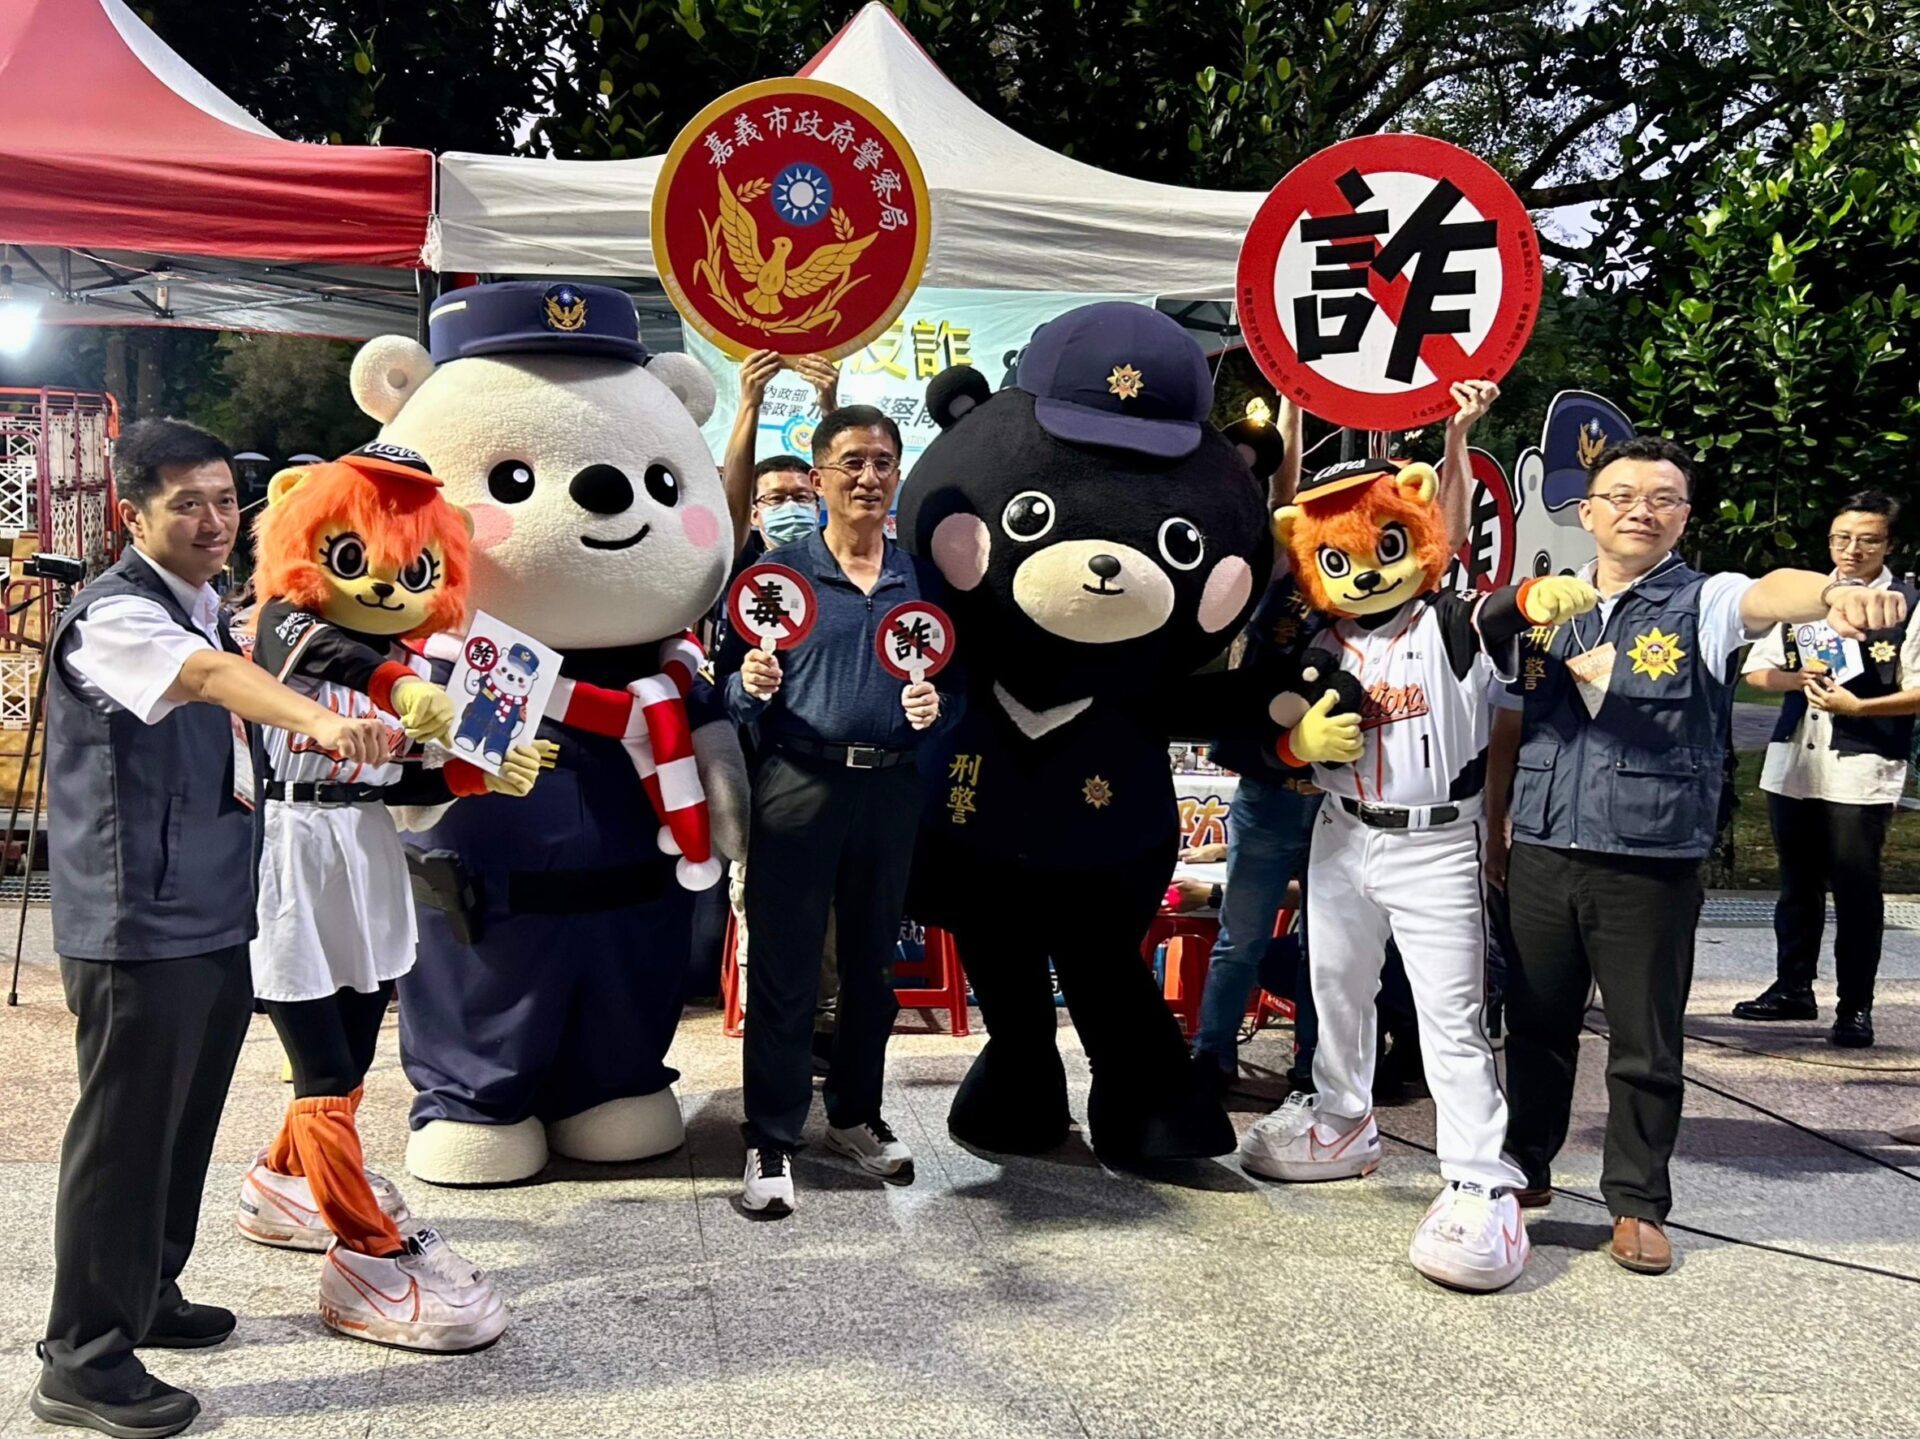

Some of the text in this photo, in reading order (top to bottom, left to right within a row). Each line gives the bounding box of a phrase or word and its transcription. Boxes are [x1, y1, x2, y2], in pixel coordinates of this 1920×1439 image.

[703, 105, 909, 232] 嘉義市政府警察局
[1293, 167, 1498, 384] 詐
[746, 580, 790, 628] 毒
[470, 641, 494, 666] 詐
[892, 616, 932, 662] 詐
[1522, 624, 1560, 691] 刑警
[1421, 734, 1430, 769] 1
[947, 753, 982, 825] 刑警
